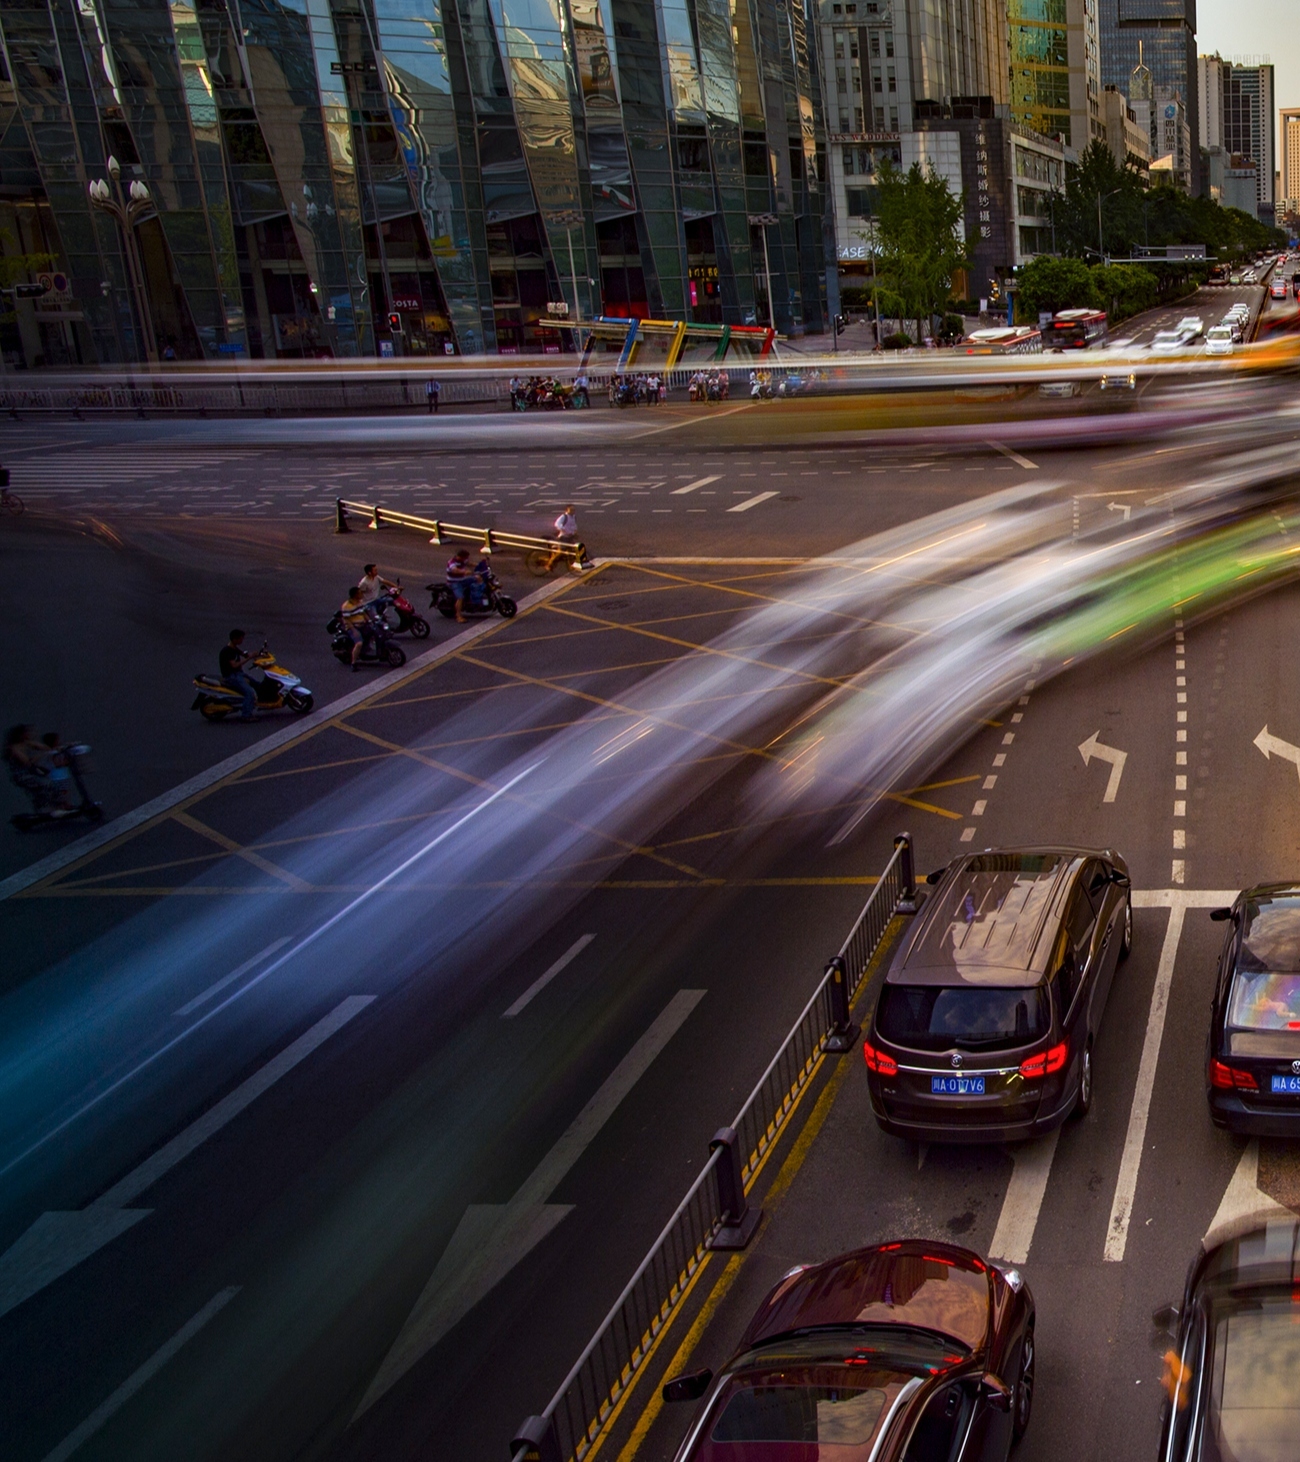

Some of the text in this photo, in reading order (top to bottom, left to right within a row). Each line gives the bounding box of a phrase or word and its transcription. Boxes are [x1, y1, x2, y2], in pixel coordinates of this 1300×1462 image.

[851, 133, 900, 141] WEDDING
[974, 133, 992, 239] 维纳斯婚纱摄影
[392, 299, 418, 307] COSTA
